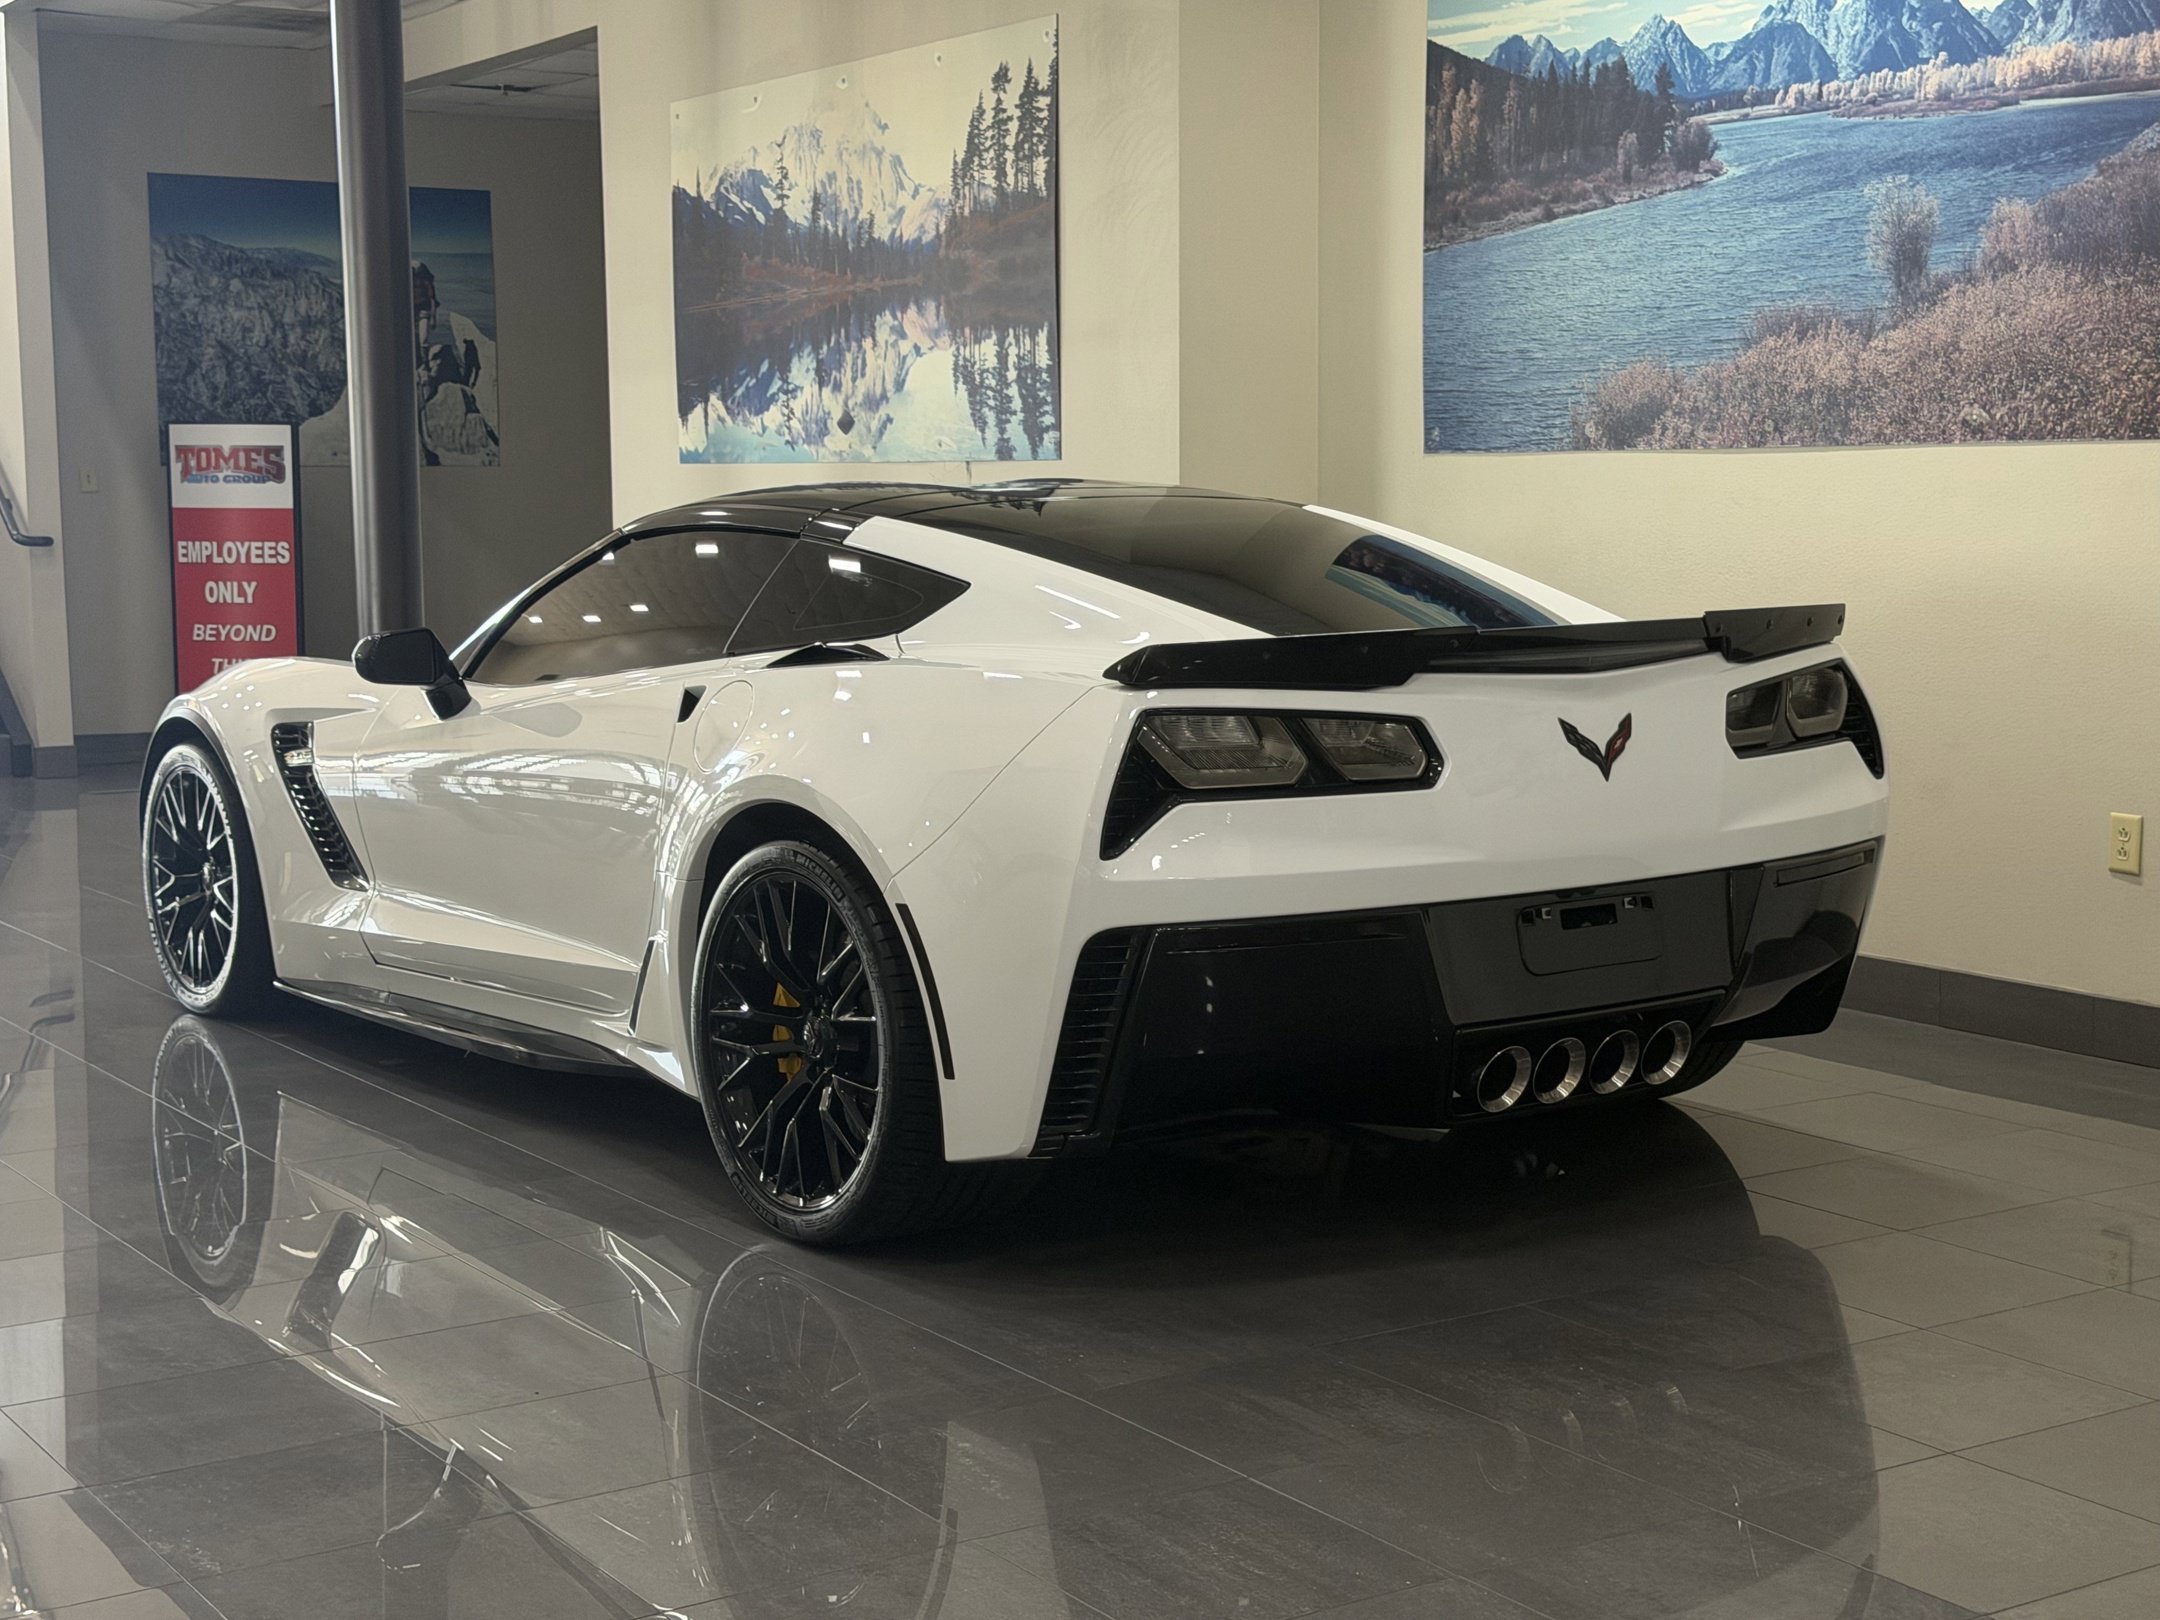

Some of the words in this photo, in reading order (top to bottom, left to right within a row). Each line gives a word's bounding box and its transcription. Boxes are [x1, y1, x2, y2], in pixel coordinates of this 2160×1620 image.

[175, 445, 286, 484] TOMES
[187, 473, 220, 484] AUTO
[223, 474, 272, 484] GROUP
[177, 541, 290, 564] EMPLOYEES
[204, 581, 257, 603] ONLY
[192, 624, 276, 642] BEYOND
[797, 855, 845, 901] MICHELIN
